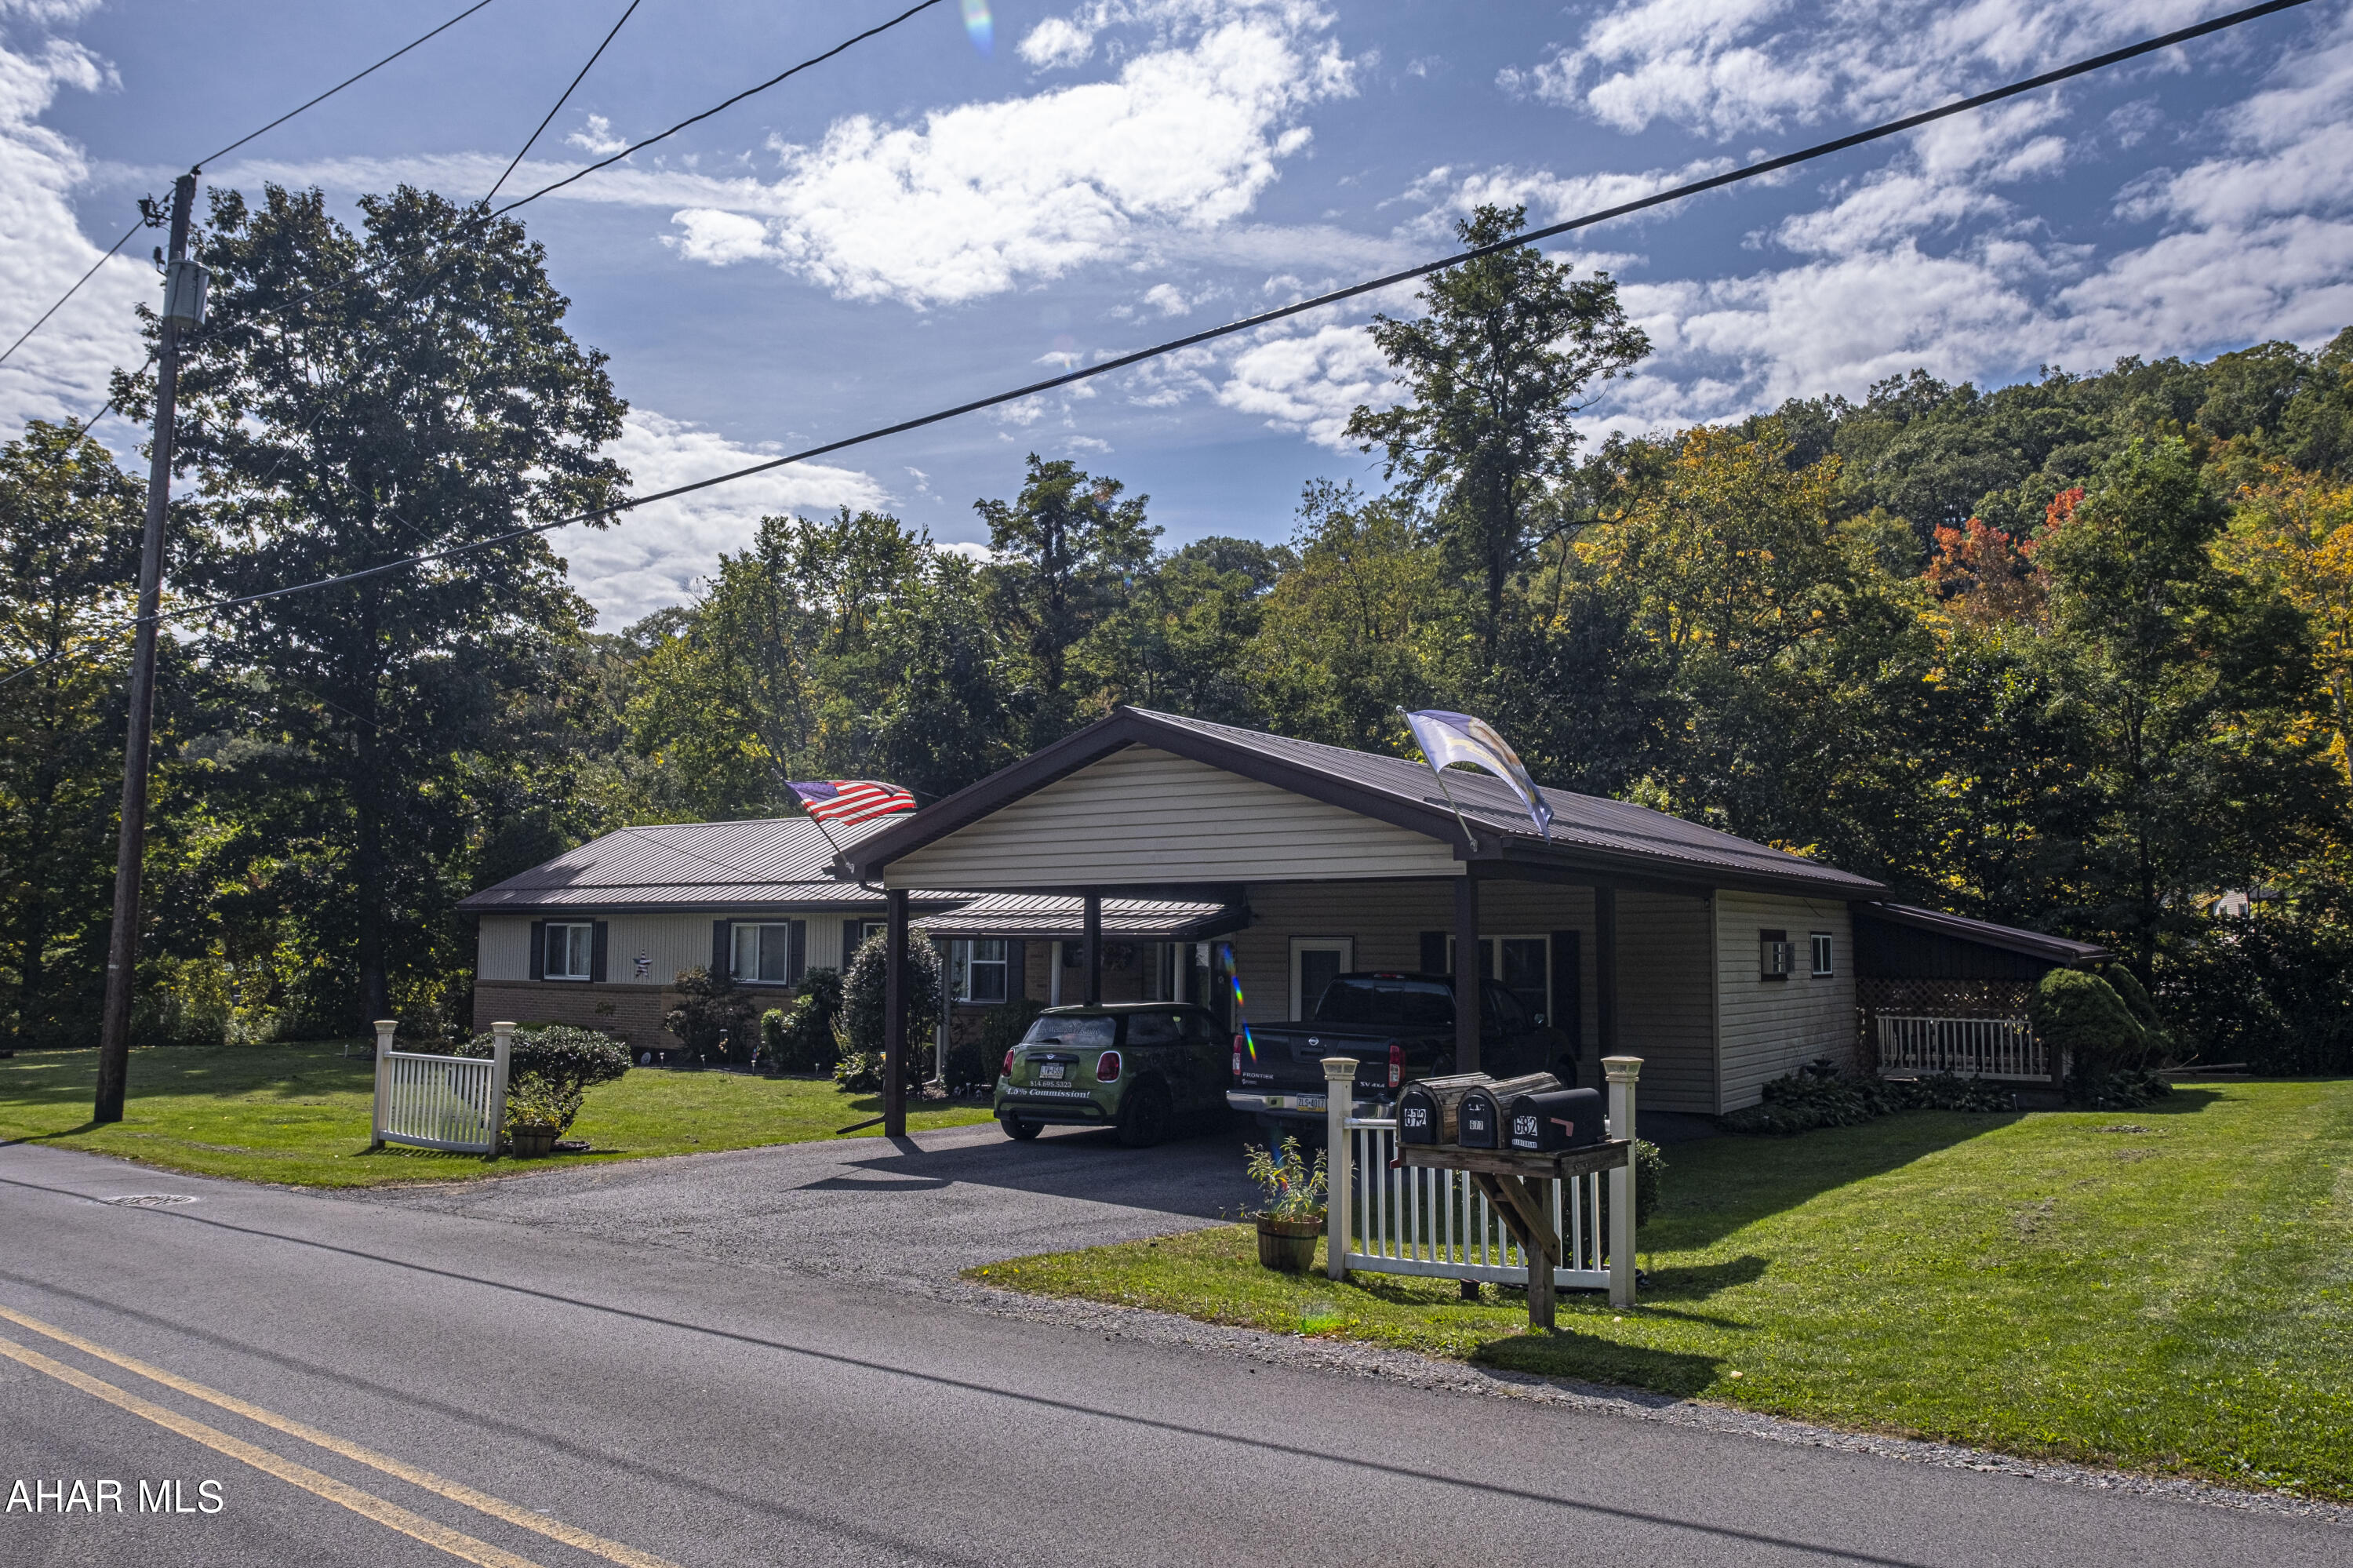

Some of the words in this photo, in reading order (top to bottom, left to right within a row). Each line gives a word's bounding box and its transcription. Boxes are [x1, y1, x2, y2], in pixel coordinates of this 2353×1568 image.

[1242, 1071, 1274, 1080] FRONTIER
[1029, 1088, 1090, 1098] Commission!
[1470, 1120, 1483, 1130] 677
[1515, 1116, 1537, 1136] 682
